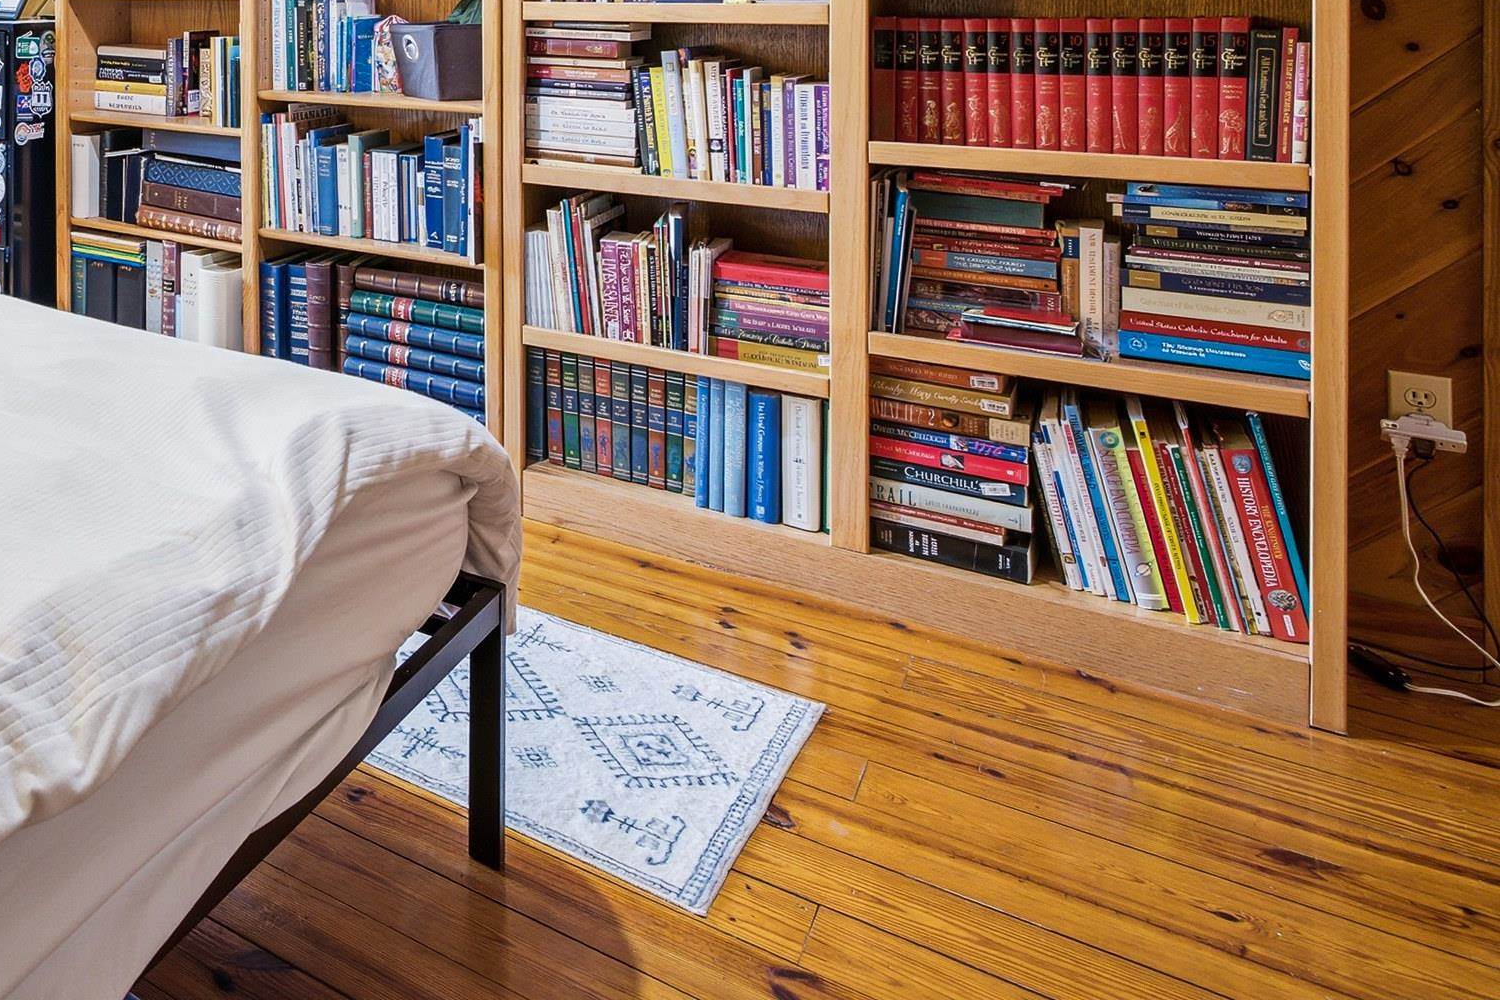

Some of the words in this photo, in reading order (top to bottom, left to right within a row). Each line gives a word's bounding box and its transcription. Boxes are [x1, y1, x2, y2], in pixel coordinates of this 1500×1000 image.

[1130, 317, 1154, 328] United
[1155, 320, 1177, 331] States
[1178, 324, 1208, 335] Catholic
[1211, 328, 1248, 340] Catechism
[1249, 332, 1261, 344] for
[1262, 334, 1288, 345] Adults
[928, 408, 935, 426] 2
[1100, 450, 1125, 485] SCIENCE
[1111, 489, 1140, 554] ENCYCLOPEDIA
[1236, 477, 1256, 516] HISTORY
[1248, 518, 1278, 588] ENCYCLOPEDIA
